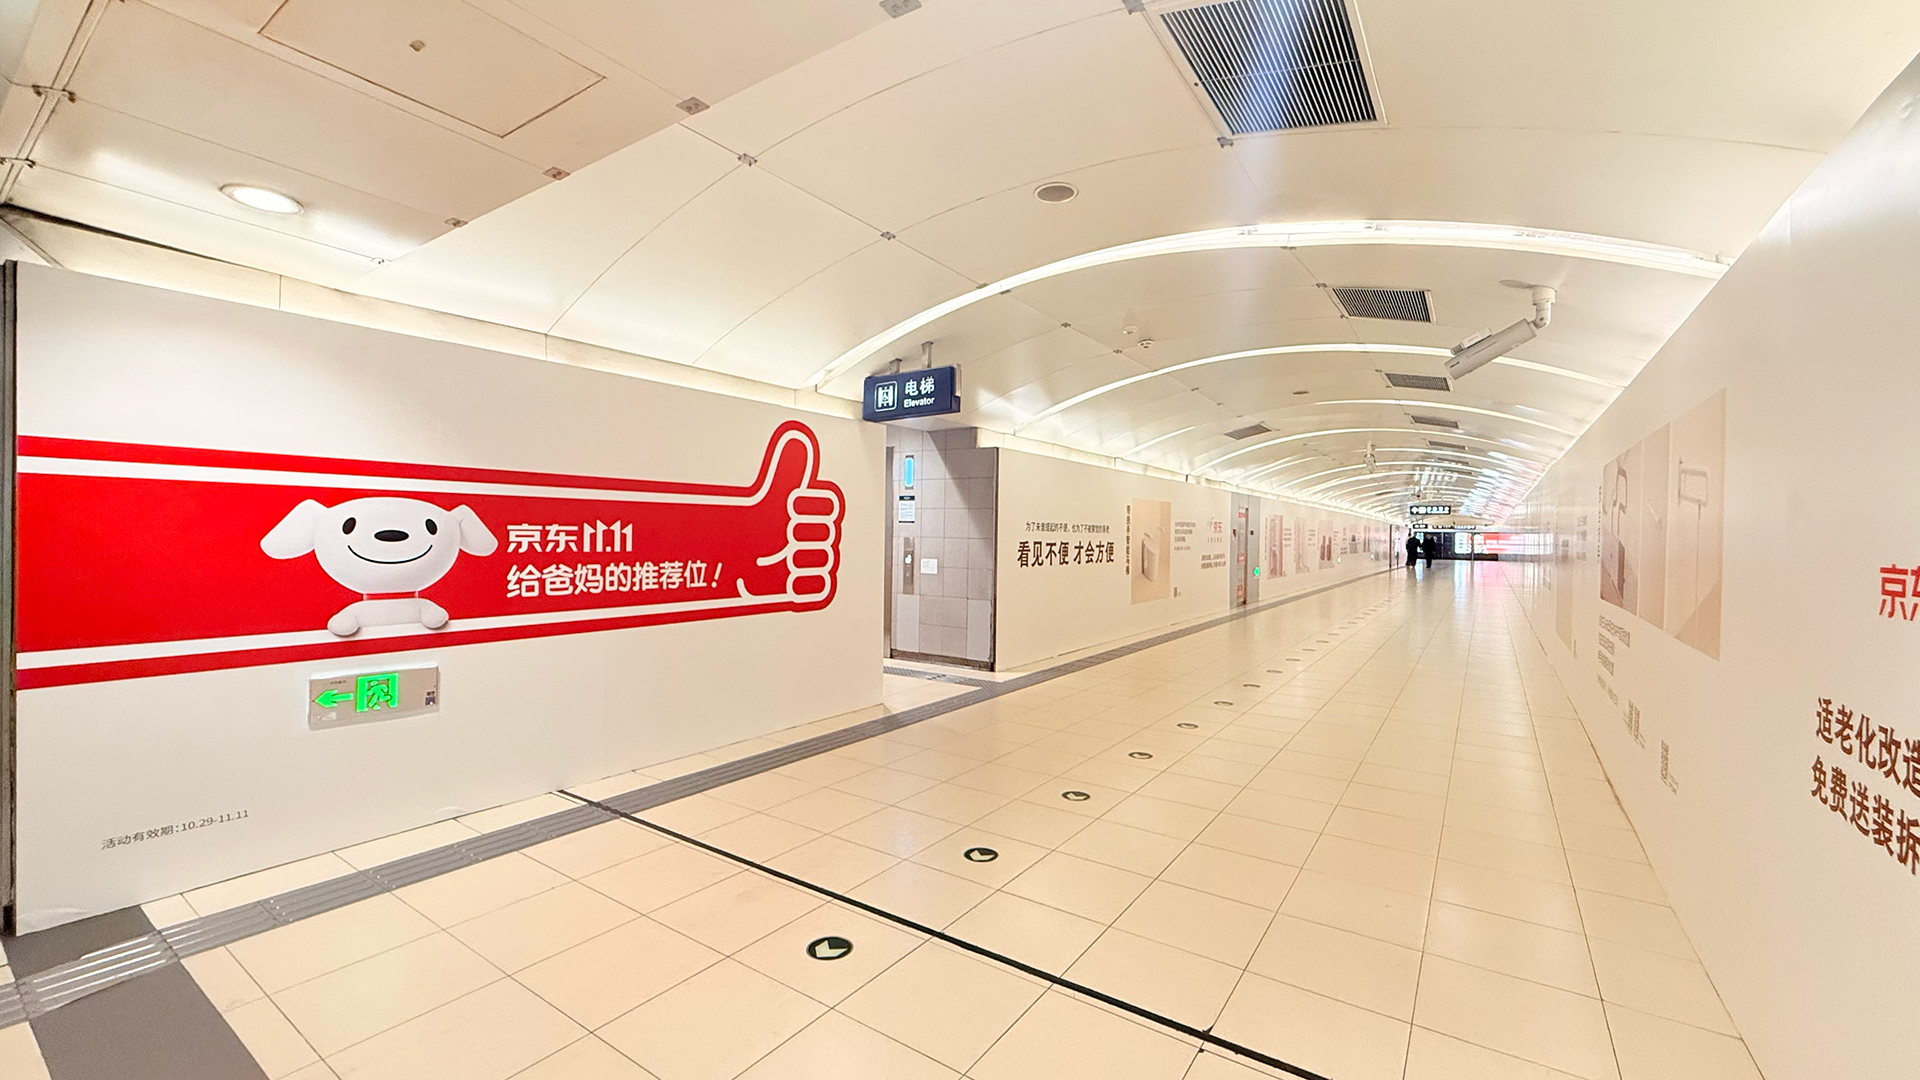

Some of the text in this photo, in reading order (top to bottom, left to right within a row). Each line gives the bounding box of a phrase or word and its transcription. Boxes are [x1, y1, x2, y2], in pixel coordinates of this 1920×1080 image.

[903, 397, 935, 408] Elevator
[905, 376, 935, 396] 电梯
[1017, 540, 1115, 568] 看见不便 才会方便
[506, 559, 723, 598] 给爸妈的推荐位!
[1878, 563, 1920, 622] 京
[100, 809, 249, 851] 活动有效期:10.29-11.11
